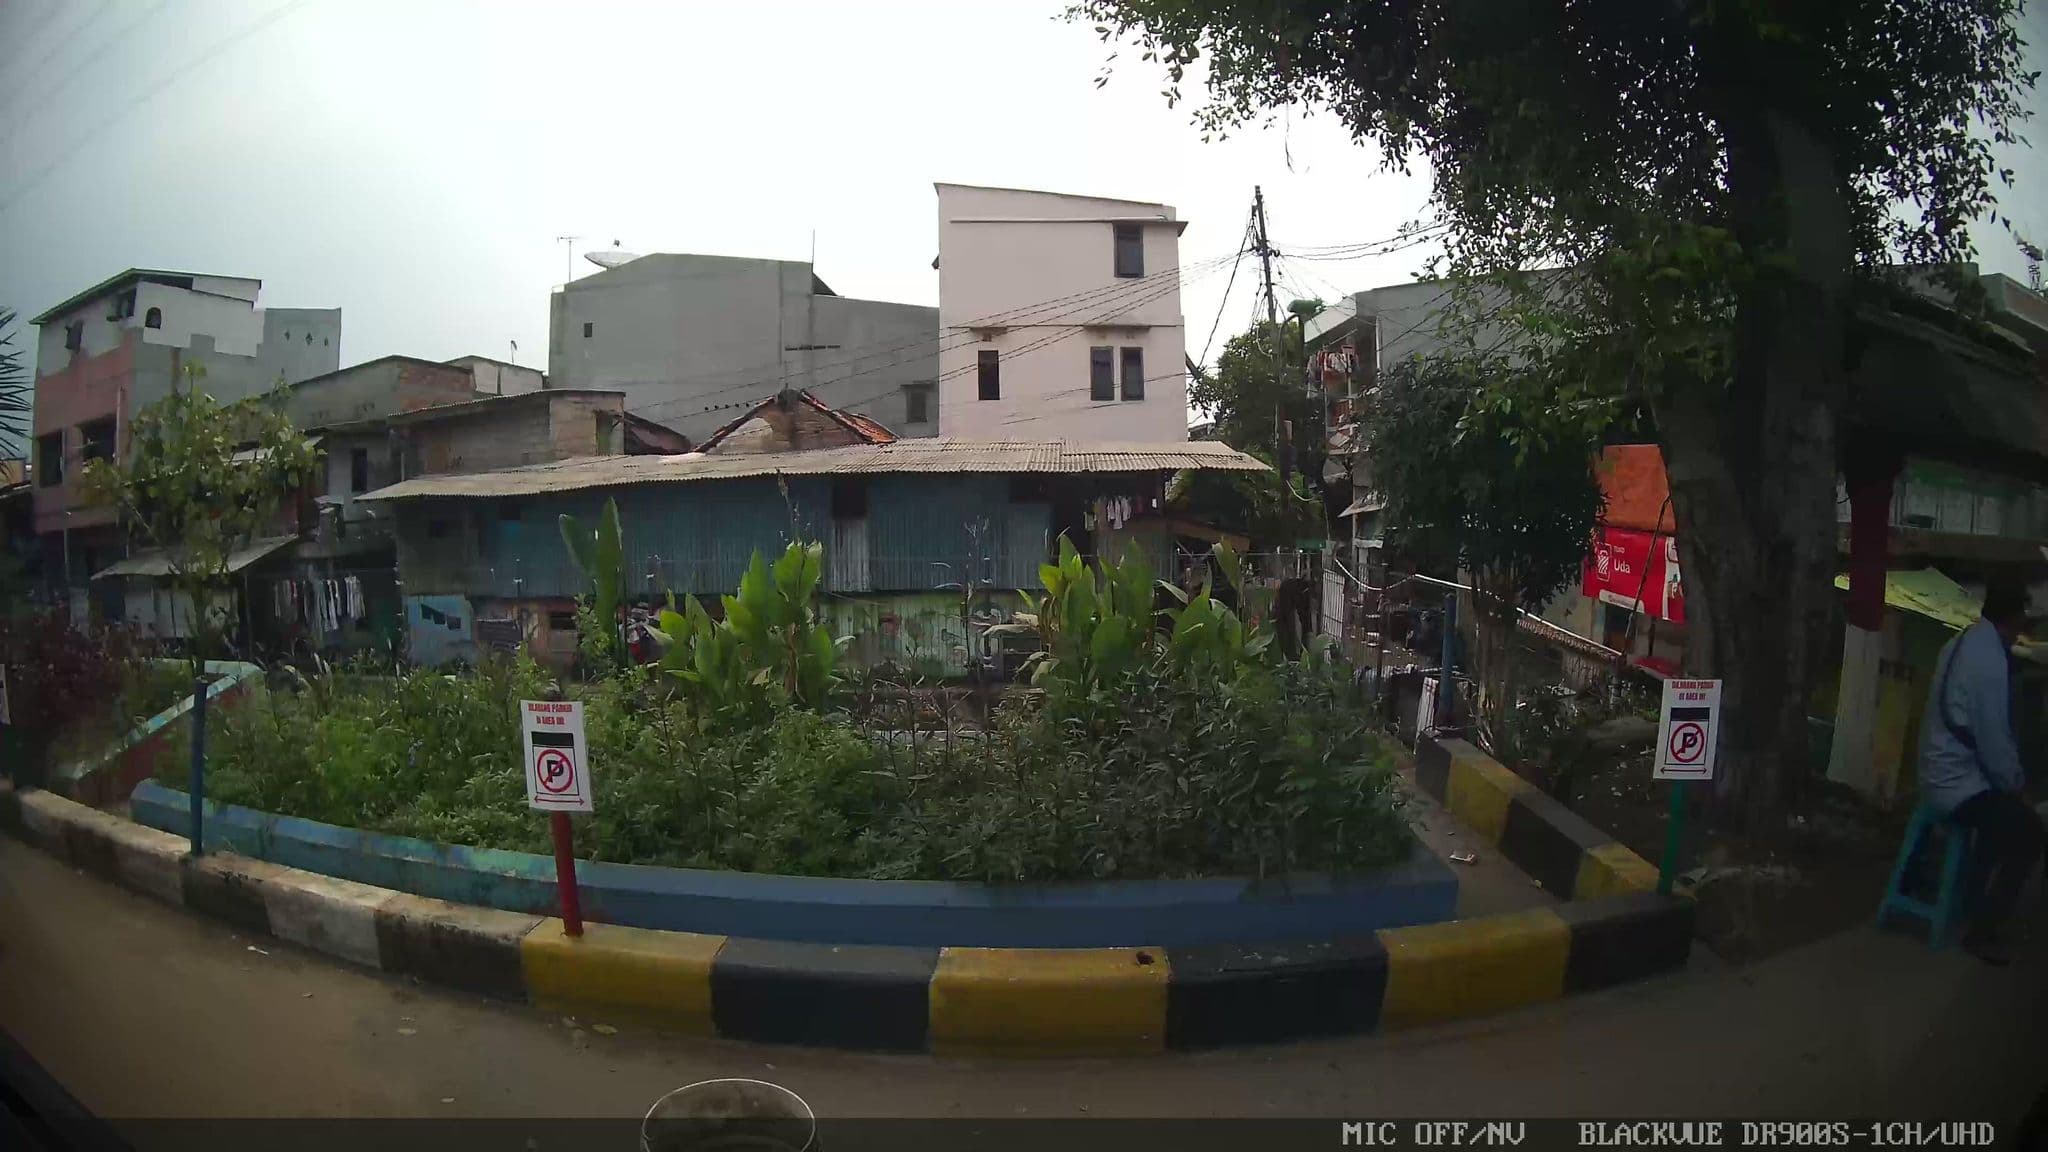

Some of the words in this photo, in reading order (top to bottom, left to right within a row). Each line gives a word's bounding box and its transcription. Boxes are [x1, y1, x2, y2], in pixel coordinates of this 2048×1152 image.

[1613, 559, 1631, 574] Uda
[1681, 732, 1698, 753] P
[546, 760, 564, 783] P
